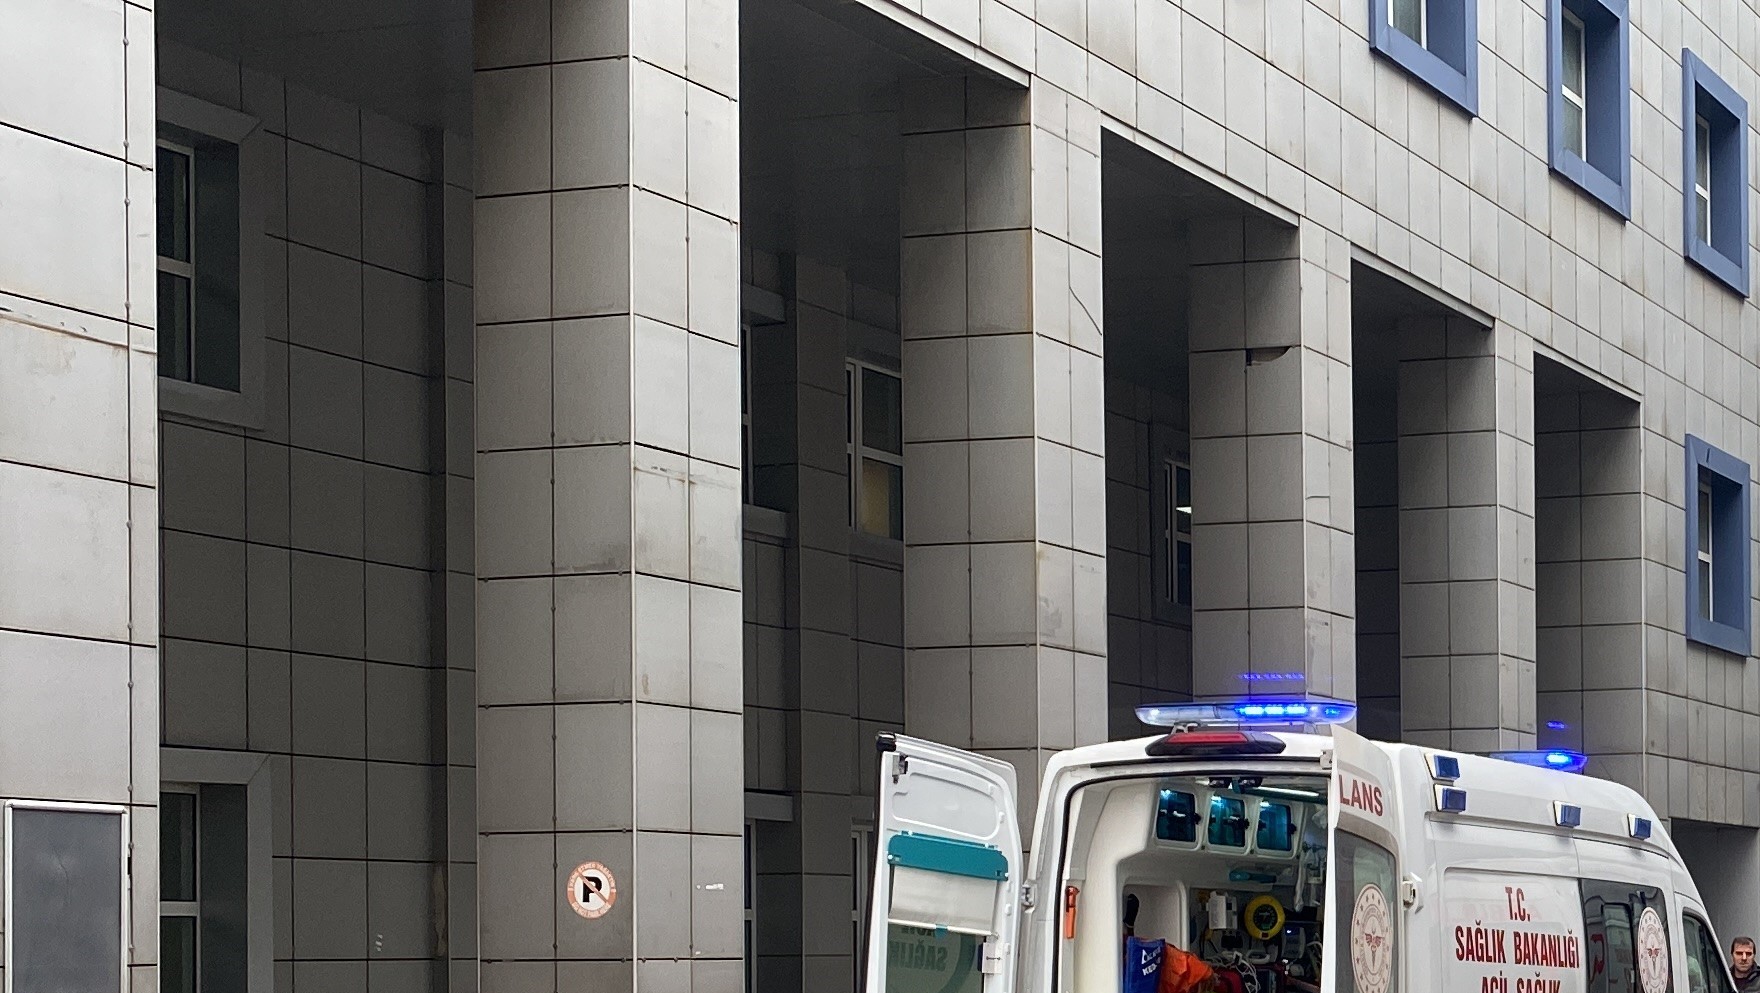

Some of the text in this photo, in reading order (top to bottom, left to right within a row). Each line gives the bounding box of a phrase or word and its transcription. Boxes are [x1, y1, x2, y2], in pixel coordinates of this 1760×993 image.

[1338, 774, 1383, 817] LANS
[1505, 886, 1531, 922] T.C.
[1455, 920, 1580, 968] SAĞLIK BAKANLIĞI
